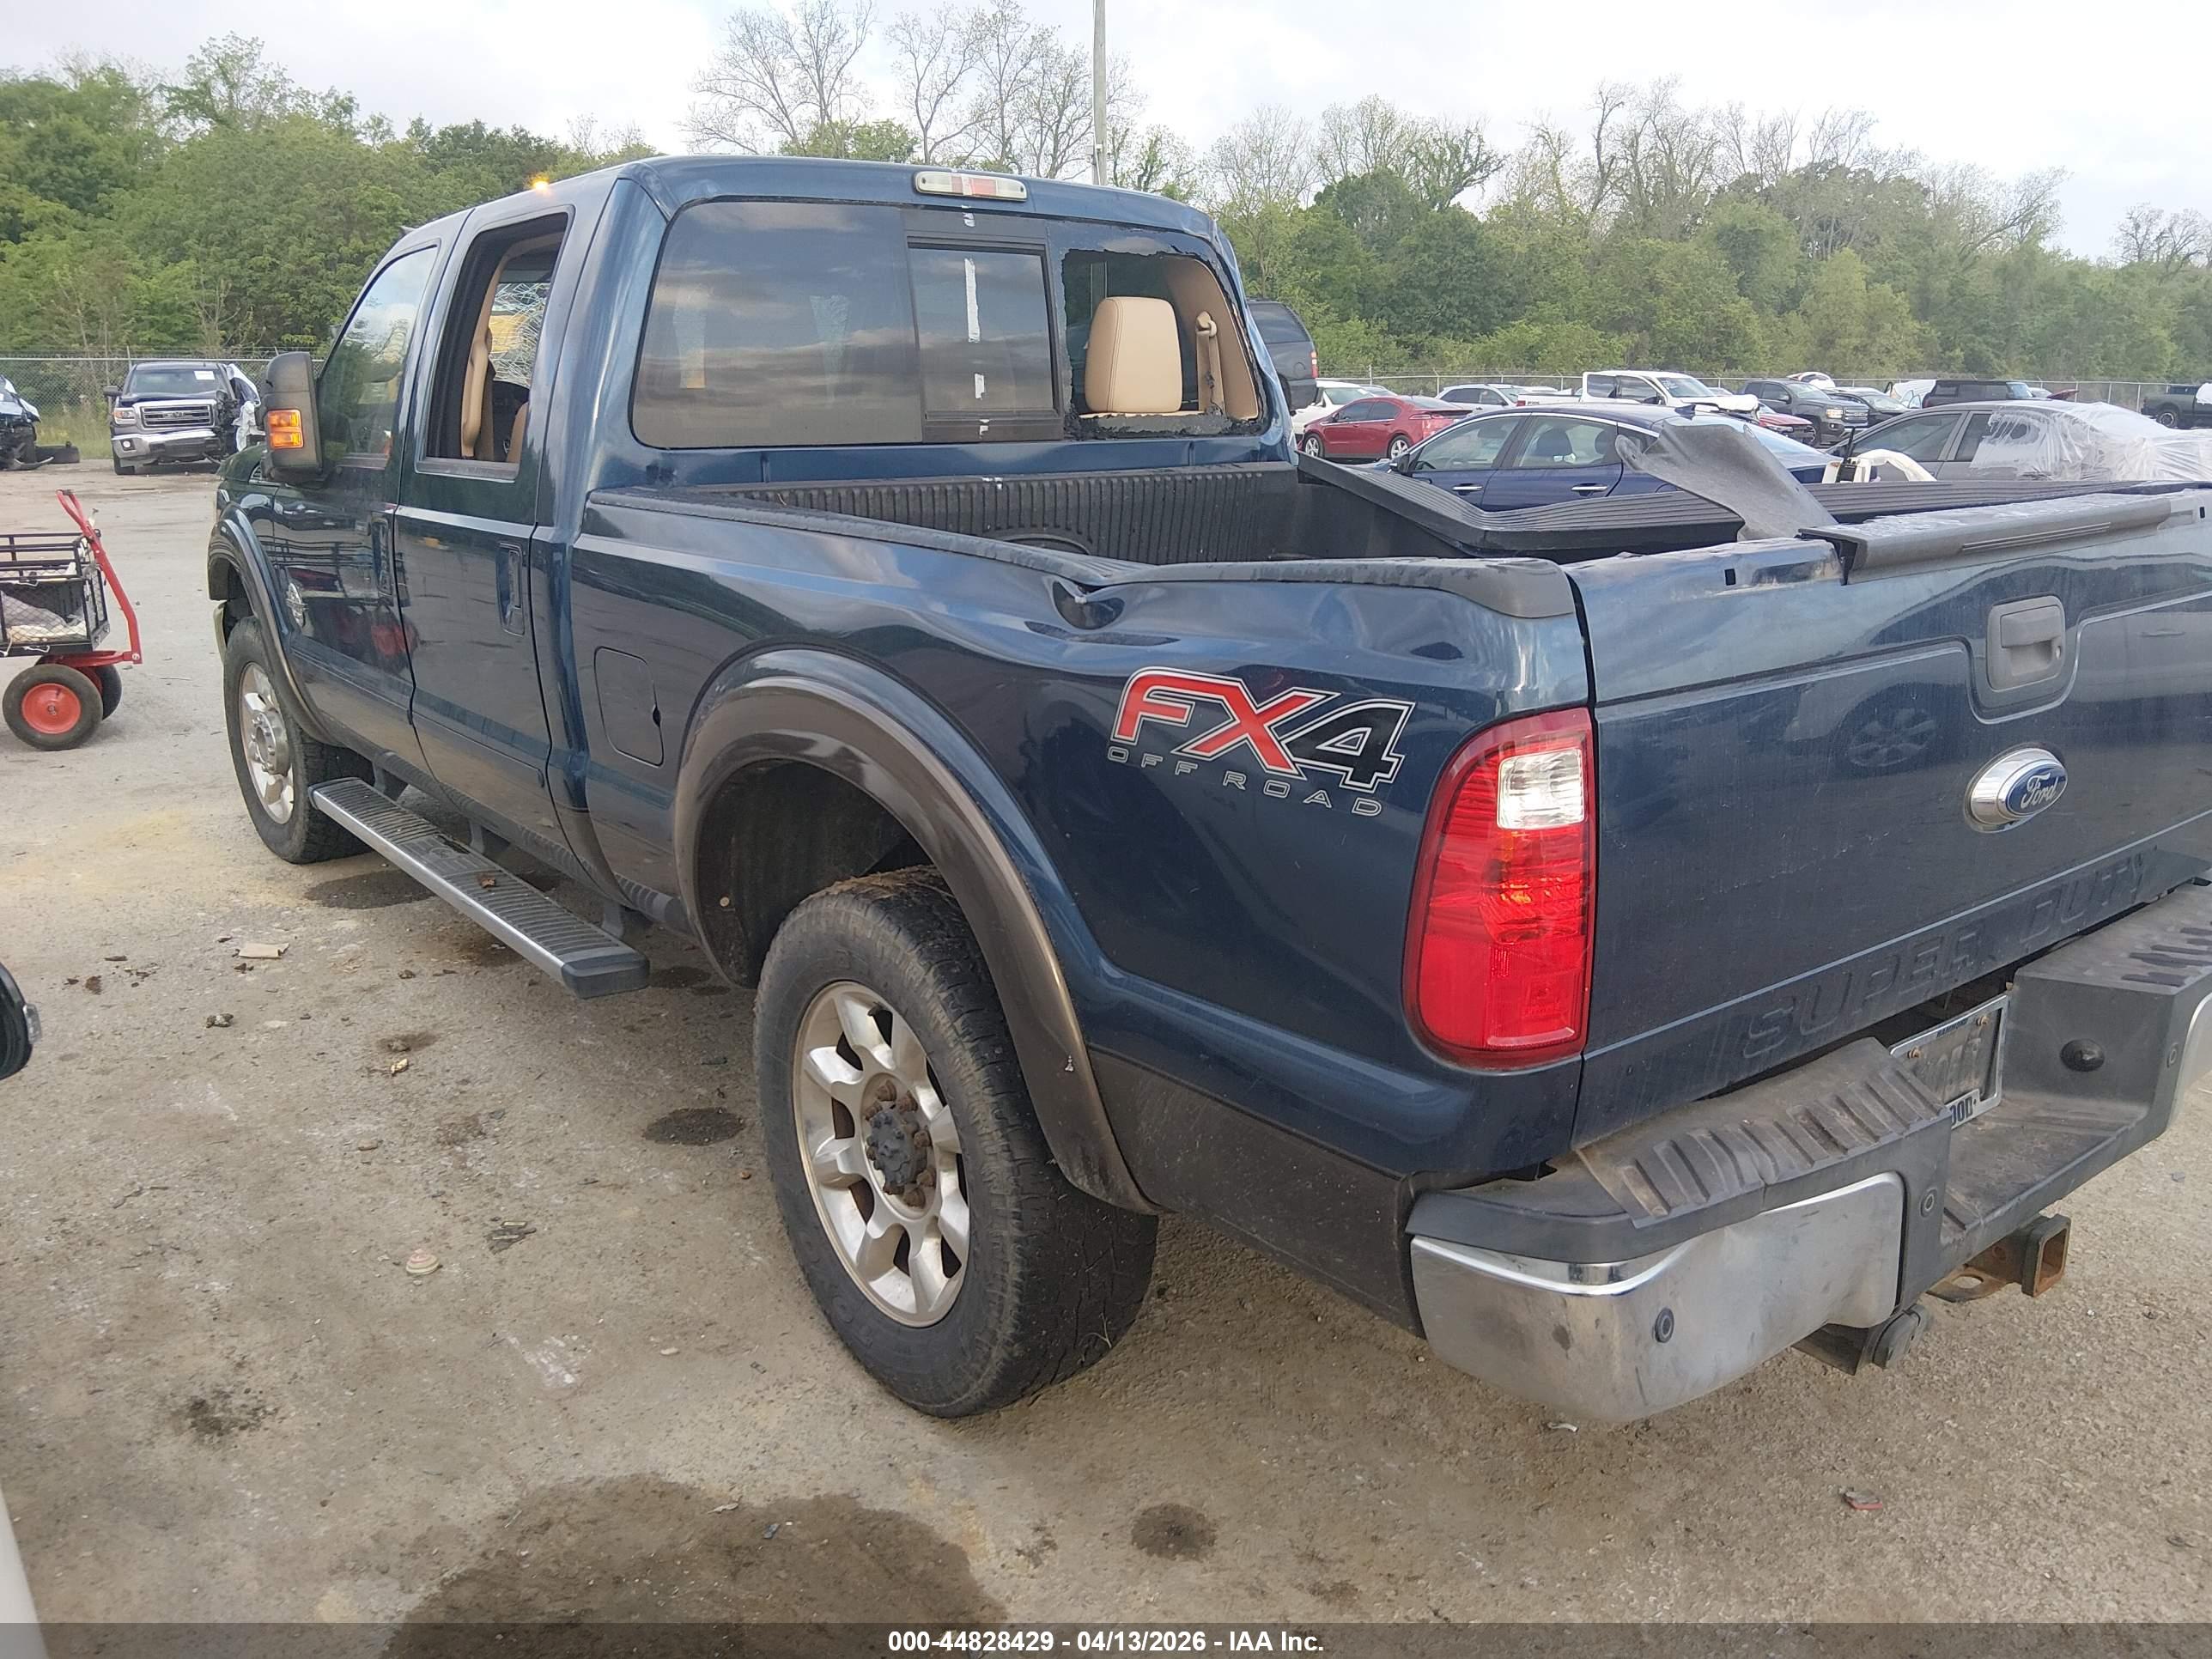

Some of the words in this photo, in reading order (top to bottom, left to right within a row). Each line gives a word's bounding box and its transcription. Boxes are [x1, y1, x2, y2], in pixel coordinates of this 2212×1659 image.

[1110, 665, 1416, 793] FX4
[1107, 745, 1198, 775] OFF
[1223, 770, 1382, 817] ROAD
[2020, 772, 2060, 810] Ford
[1743, 915, 1996, 1060] SUPER
[2018, 844, 2158, 945] DUTY
